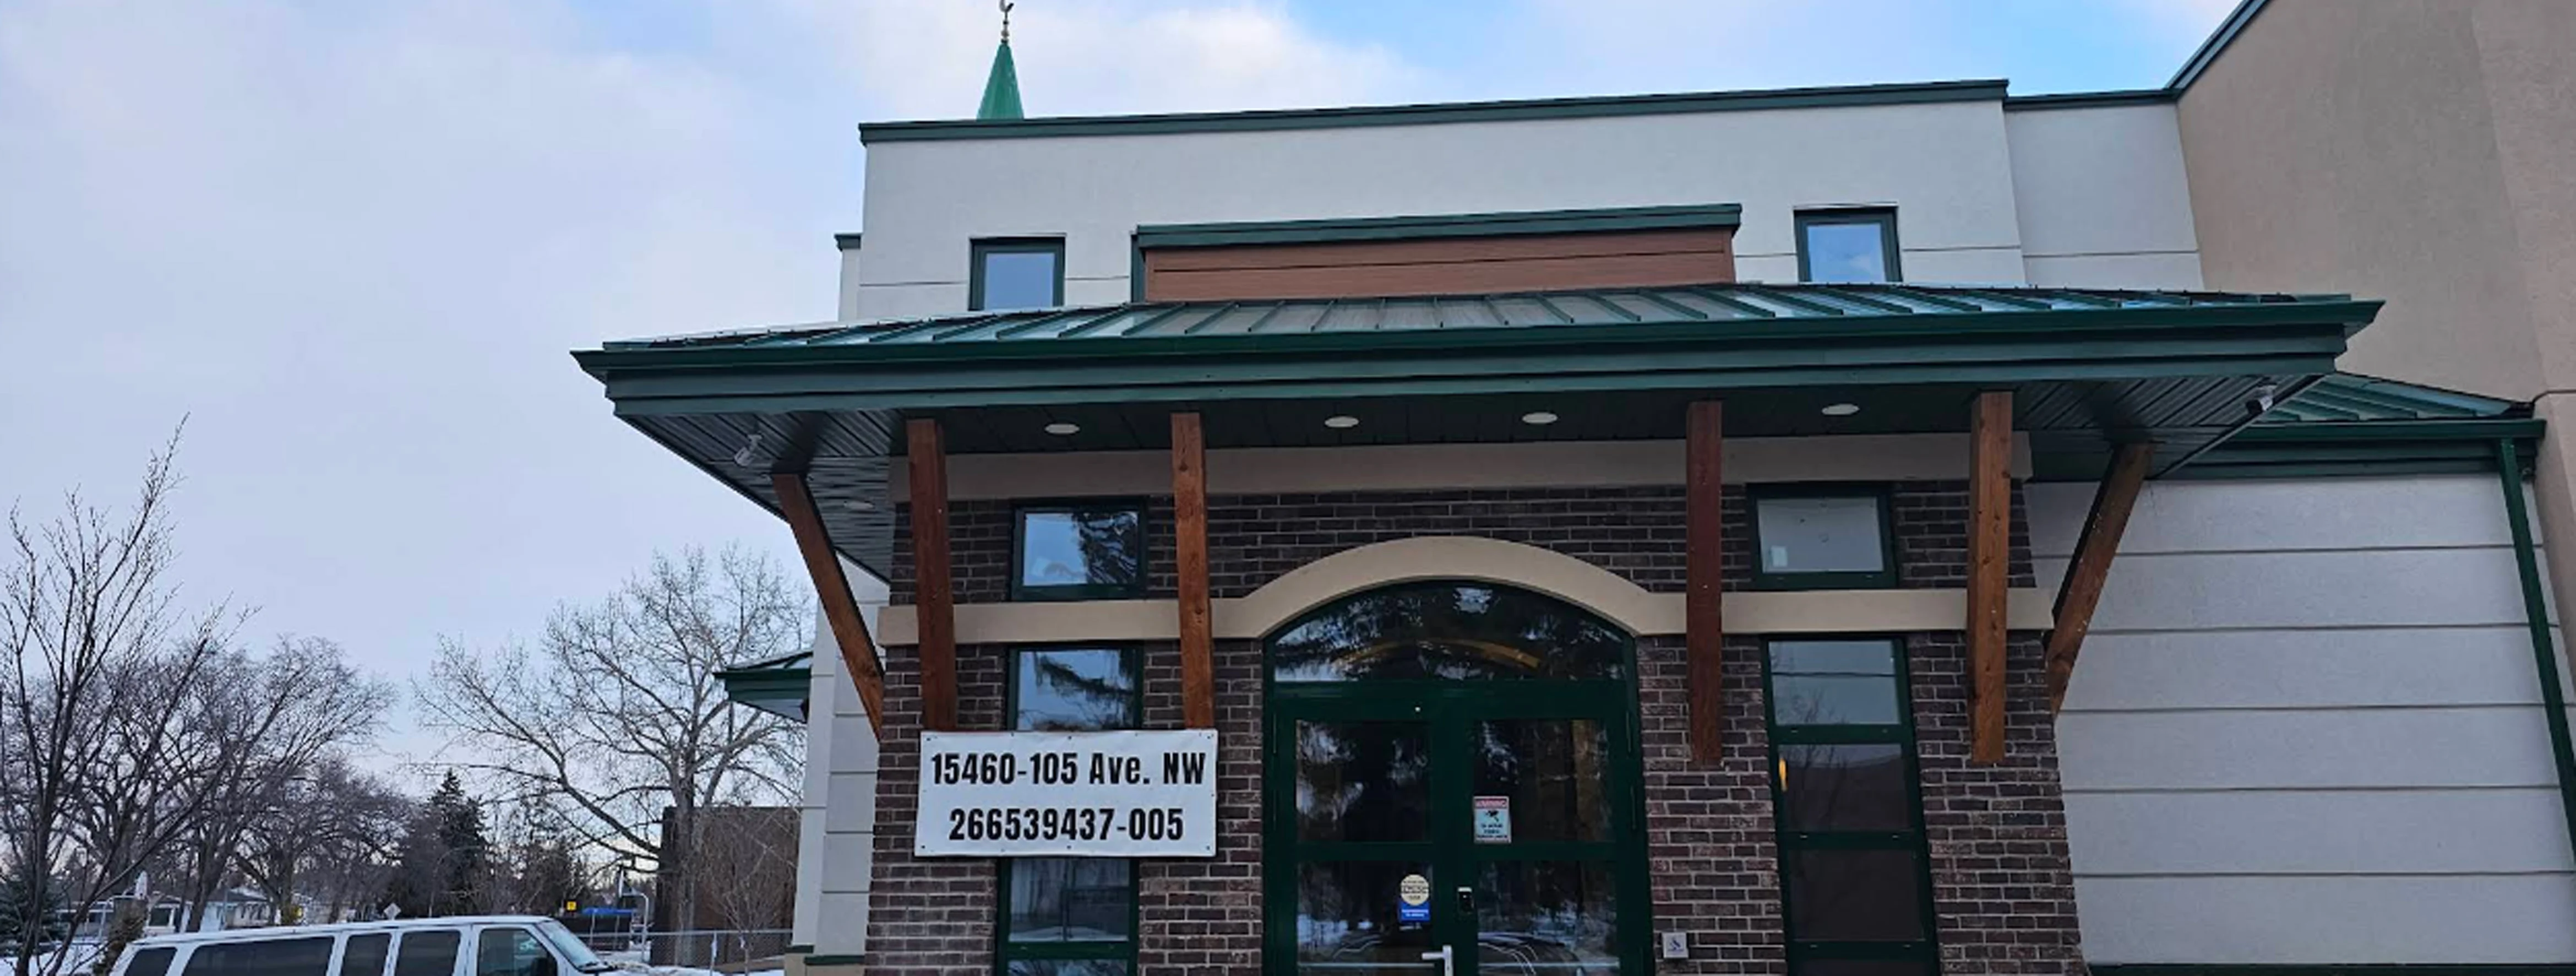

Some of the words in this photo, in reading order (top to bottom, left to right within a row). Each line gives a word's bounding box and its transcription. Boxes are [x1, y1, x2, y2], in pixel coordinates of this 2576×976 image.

[932, 752, 1077, 785] 15460-105
[1089, 753, 1150, 785] Ave.
[1163, 752, 1206, 784] NW
[949, 808, 1183, 841] 266539437-005
